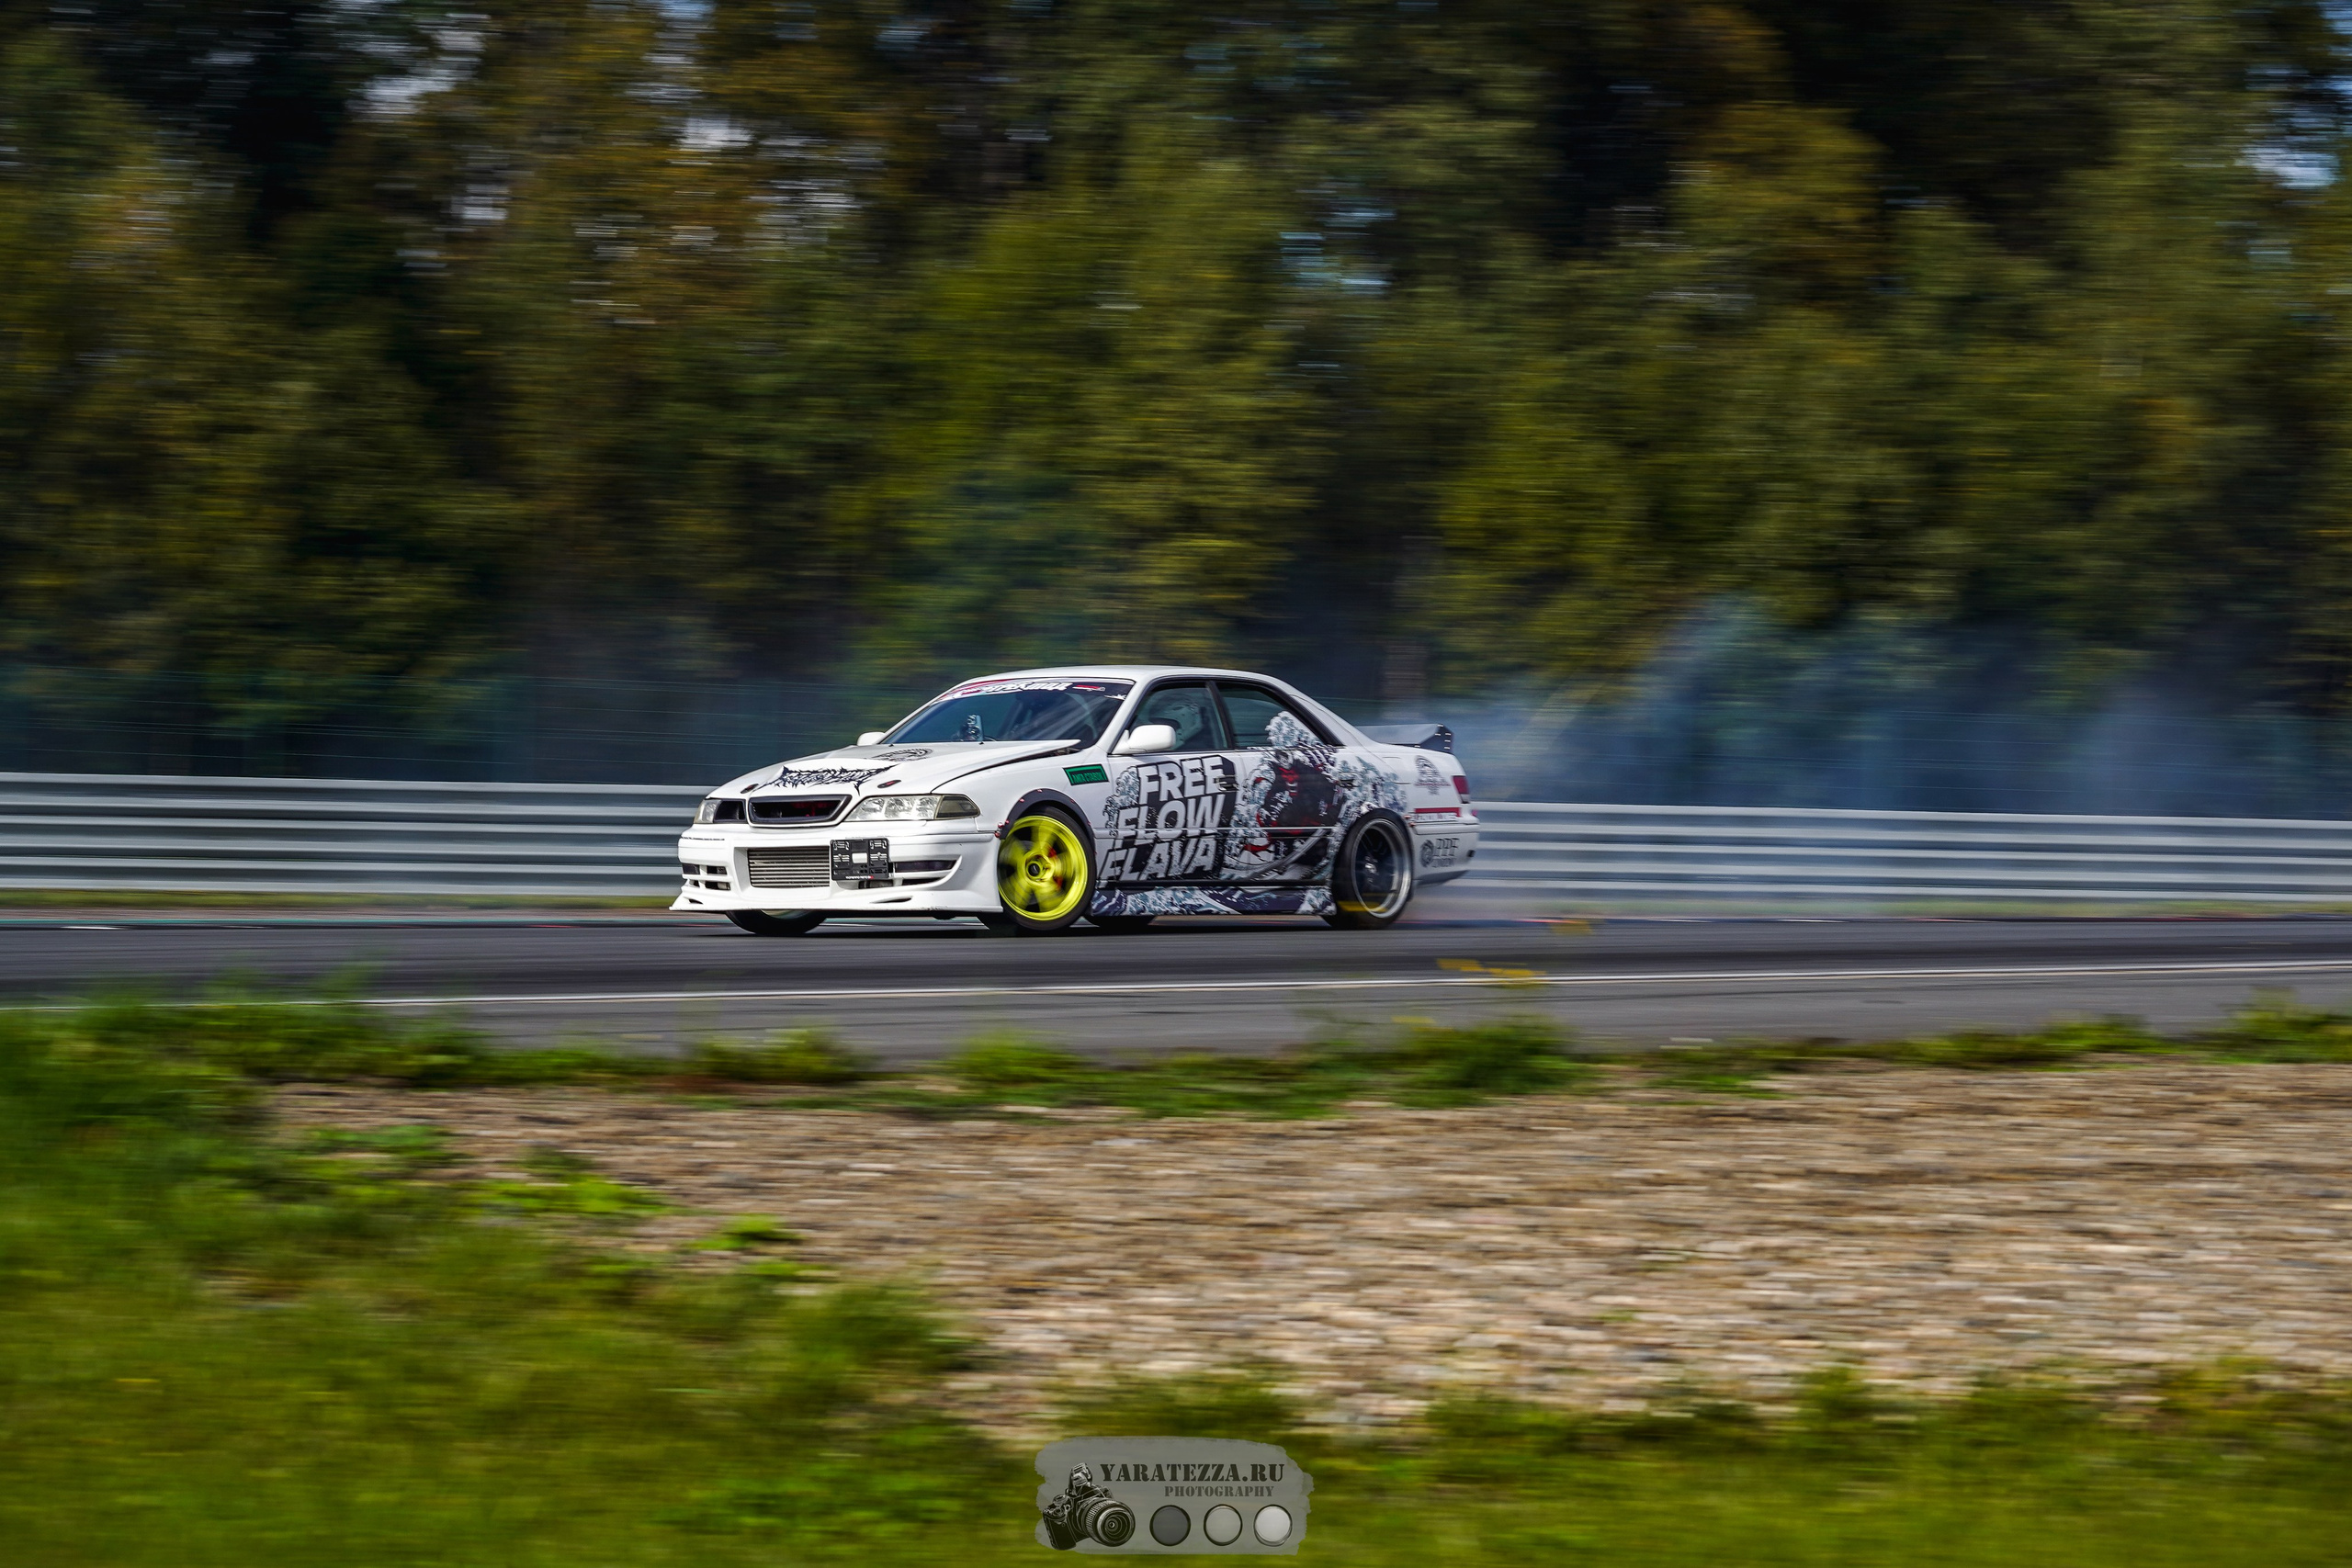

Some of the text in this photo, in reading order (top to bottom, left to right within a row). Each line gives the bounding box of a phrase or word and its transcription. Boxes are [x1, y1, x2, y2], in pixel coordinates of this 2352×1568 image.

[1137, 756, 1224, 805] FREE
[1114, 794, 1226, 849] FLOW
[1097, 835, 1217, 889] FLAVA
